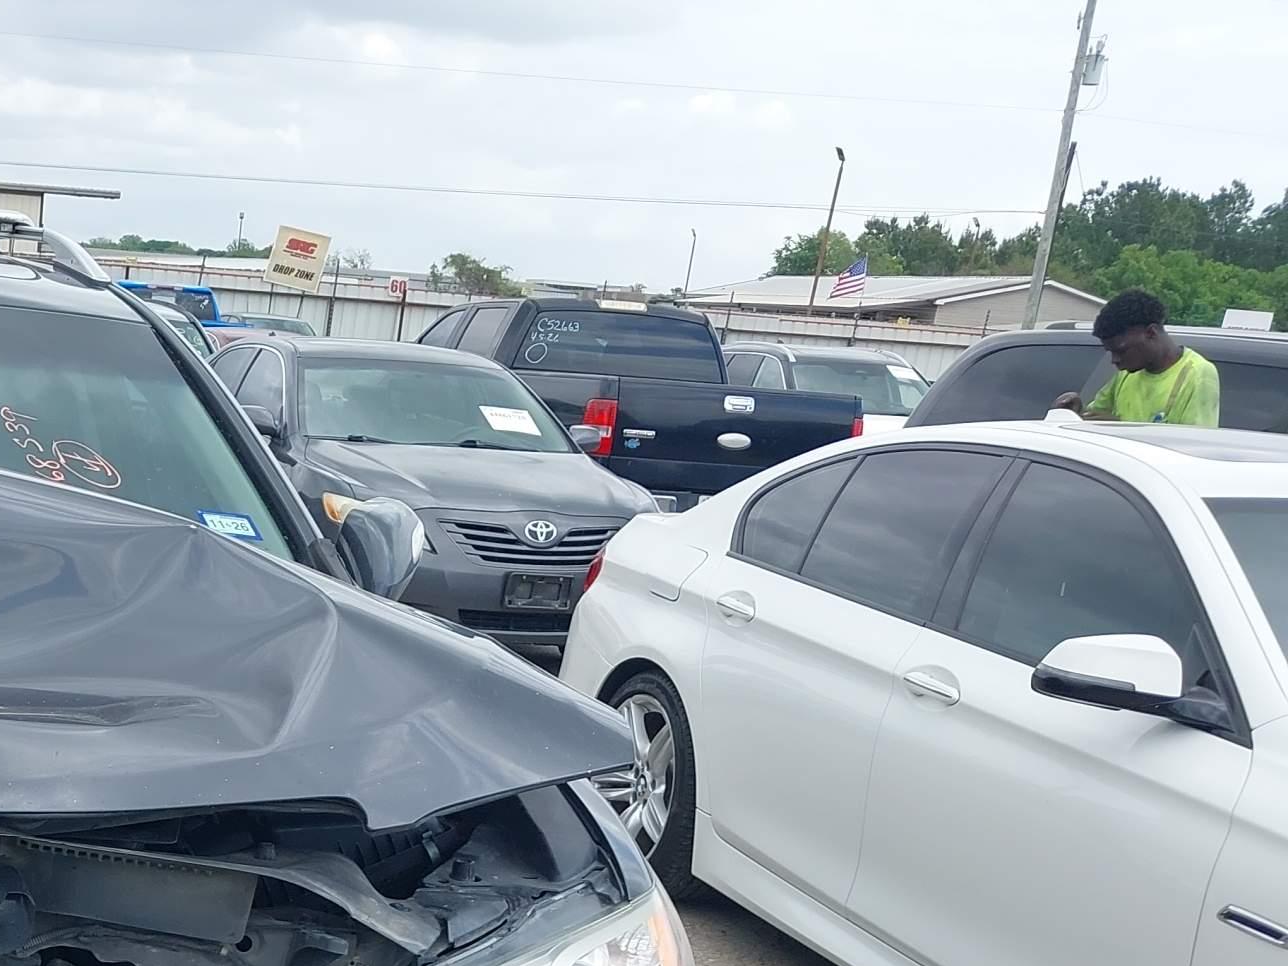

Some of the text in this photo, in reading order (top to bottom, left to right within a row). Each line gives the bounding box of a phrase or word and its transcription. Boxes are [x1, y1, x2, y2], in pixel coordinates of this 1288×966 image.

[272, 263, 316, 281] DROP ZONE
[390, 279, 407, 294] 60
